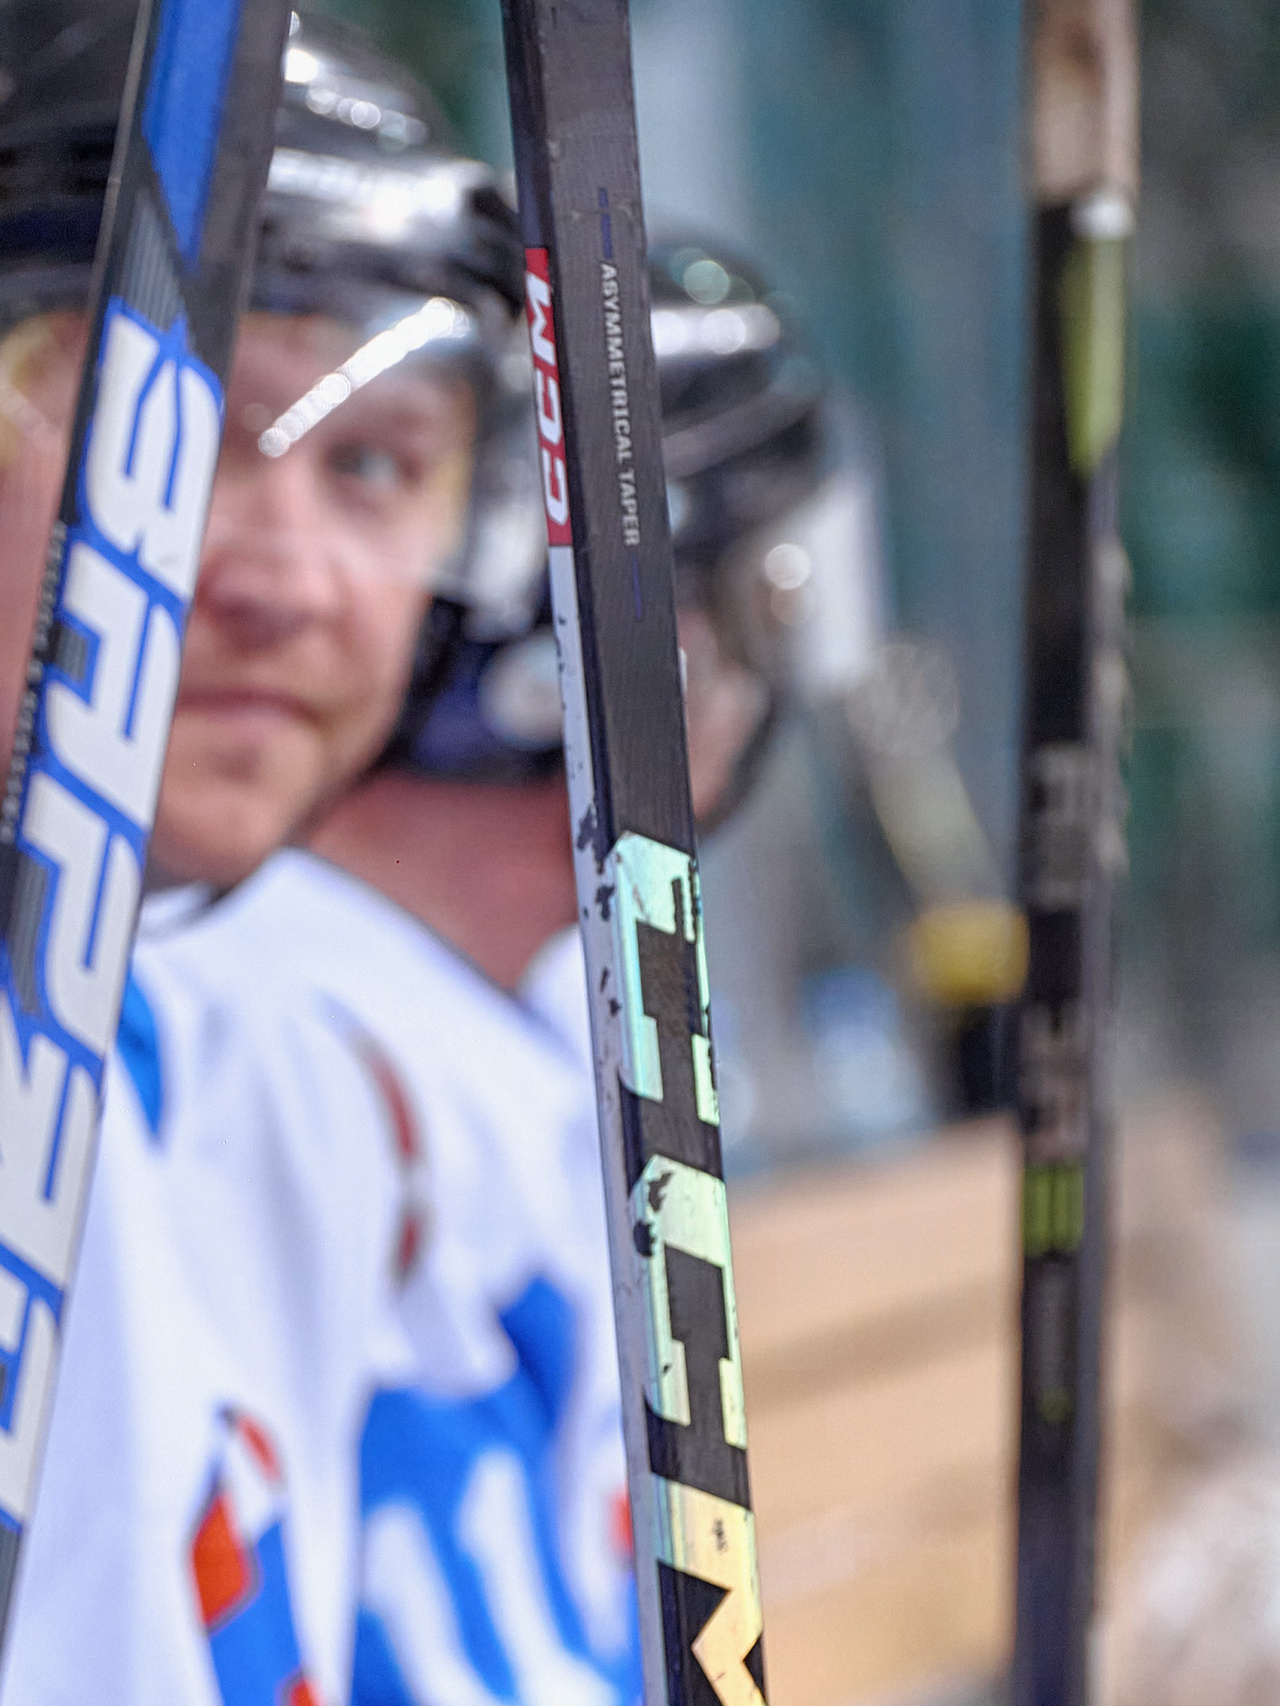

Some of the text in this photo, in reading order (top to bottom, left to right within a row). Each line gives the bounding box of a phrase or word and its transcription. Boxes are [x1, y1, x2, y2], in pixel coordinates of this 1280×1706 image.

[525, 271, 569, 527] CCM
[600, 262, 641, 547] ASYMMETRICAL TAPER
[606, 830, 768, 1706] CCM
